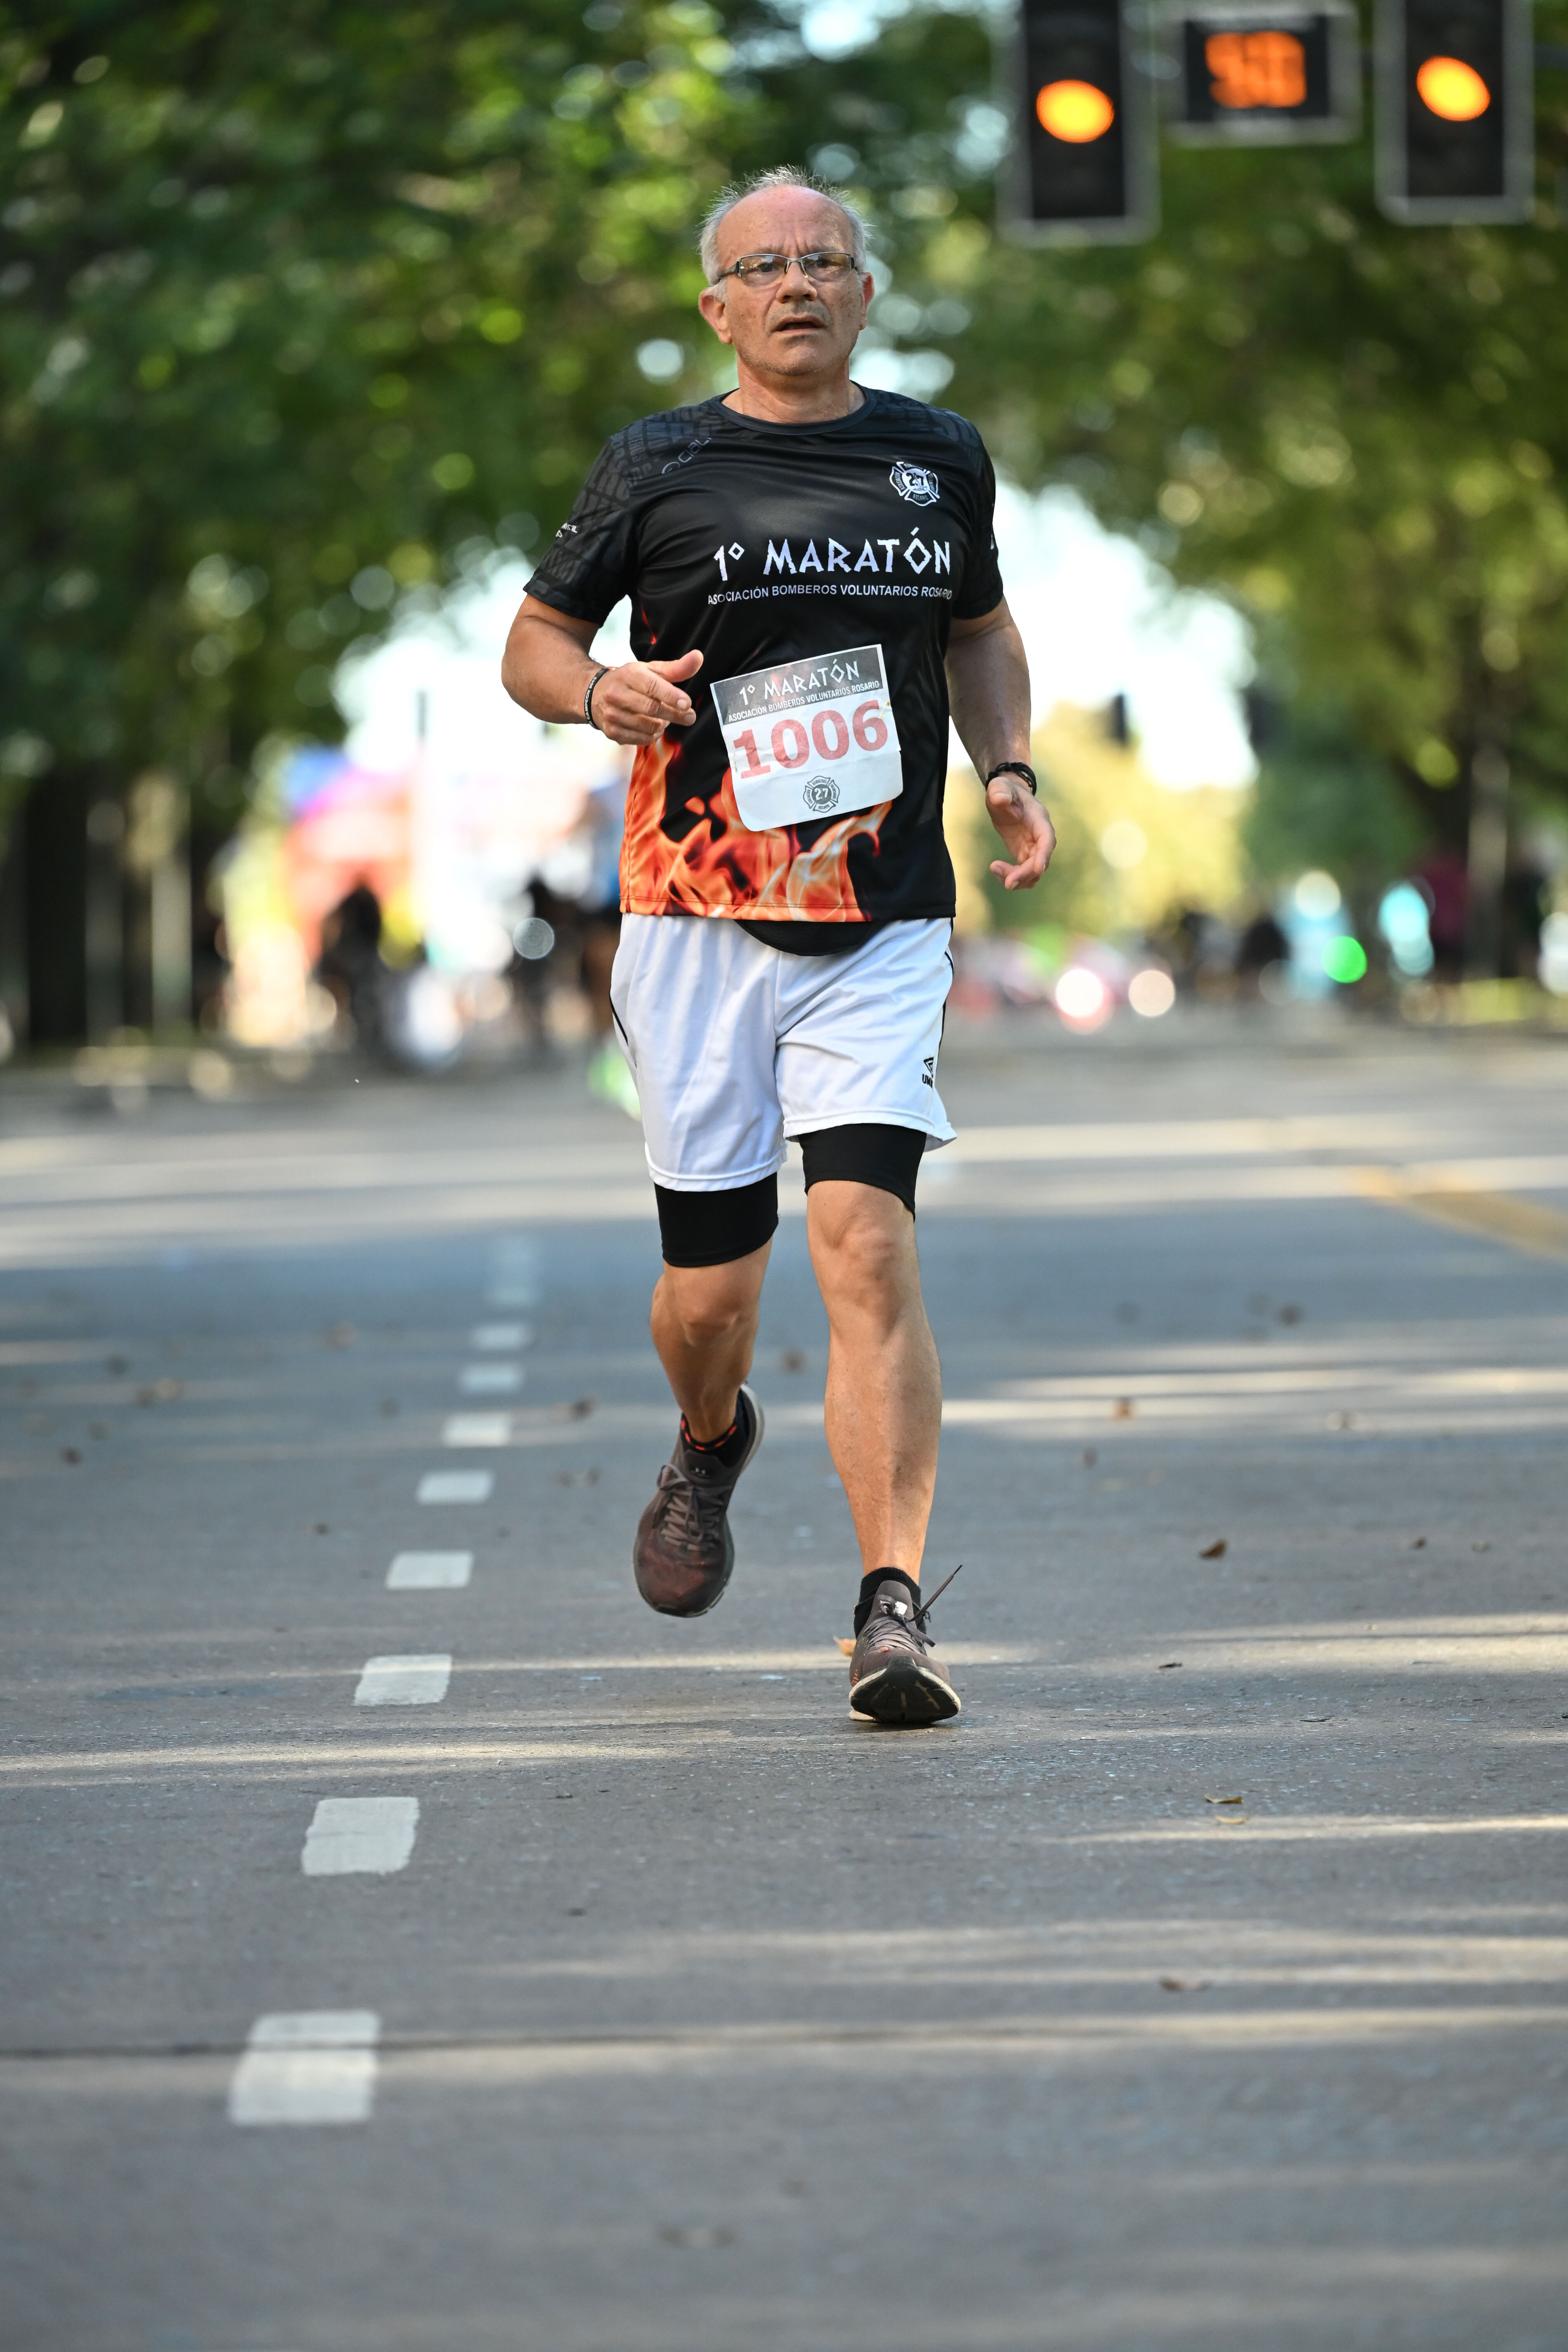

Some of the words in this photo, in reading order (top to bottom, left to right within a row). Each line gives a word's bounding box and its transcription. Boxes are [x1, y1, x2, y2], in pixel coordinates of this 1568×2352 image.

[906, 472, 924, 486] 27
[763, 527, 950, 576] MARATÓN
[708, 586, 768, 605] ASOCIACIÓN
[772, 584, 836, 596] BOMBEROS
[840, 584, 918, 597] VOLUNTARIOS
[921, 586, 952, 600] ROSARIO
[764, 658, 859, 700] MARATÓN
[728, 705, 767, 723] ASOCIACIÓN
[768, 697, 805, 712] BOMBEROS
[805, 686, 850, 703] VOLUNTARIOS
[851, 681, 880, 693] ROSARIO
[733, 699, 888, 779] 1006
[814, 788, 828, 801] 27
